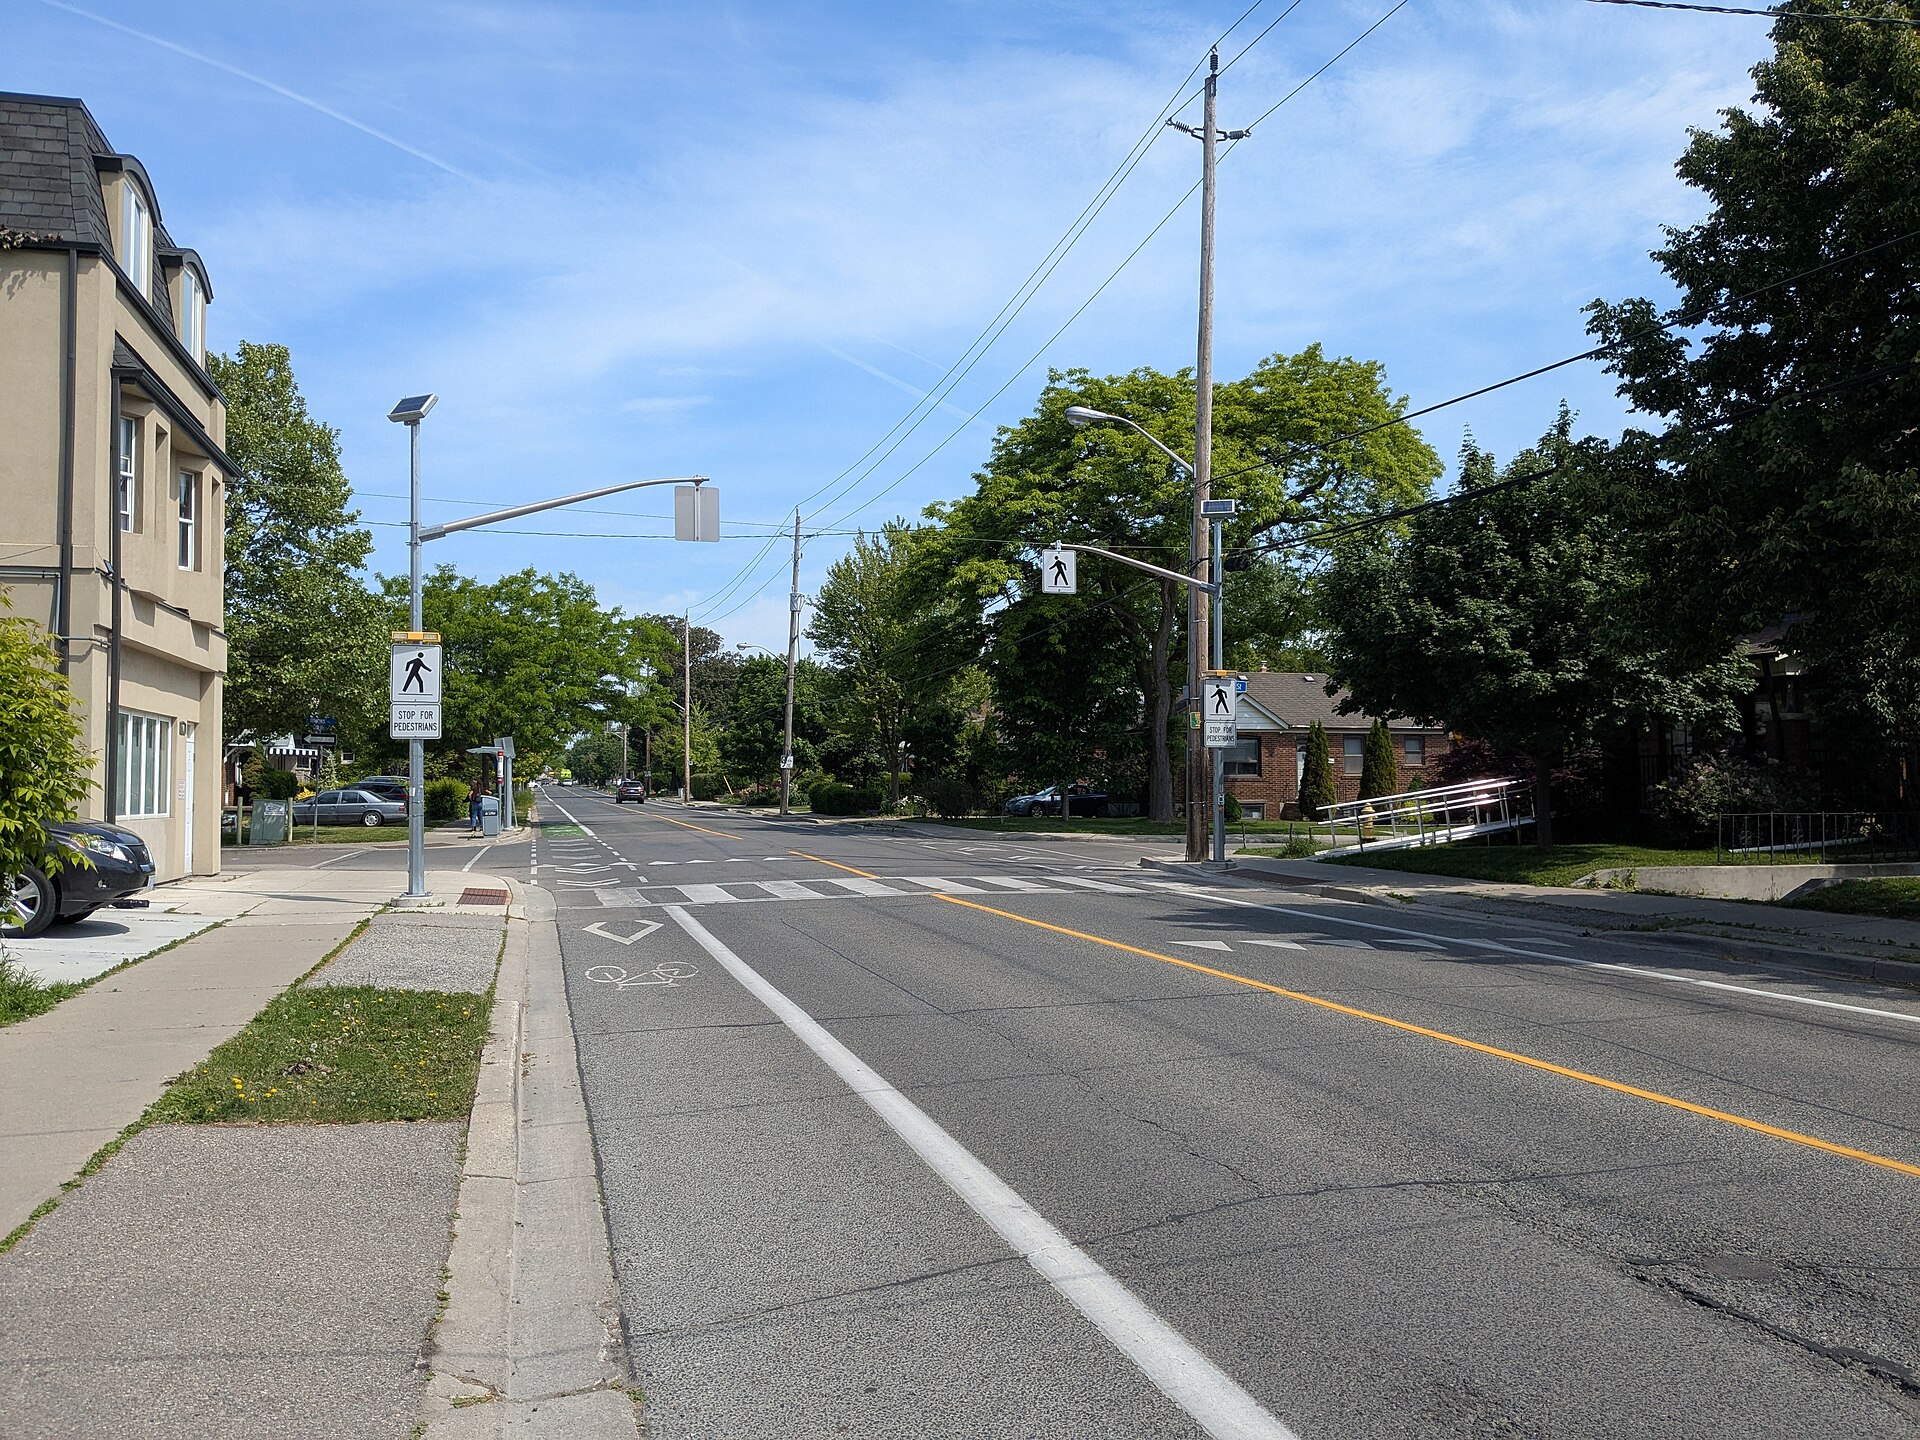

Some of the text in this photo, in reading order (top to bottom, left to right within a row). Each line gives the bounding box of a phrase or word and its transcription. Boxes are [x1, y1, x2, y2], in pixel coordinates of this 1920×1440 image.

[398, 711, 433, 720] STOP FOR
[394, 723, 437, 731] PEDESTRIANS
